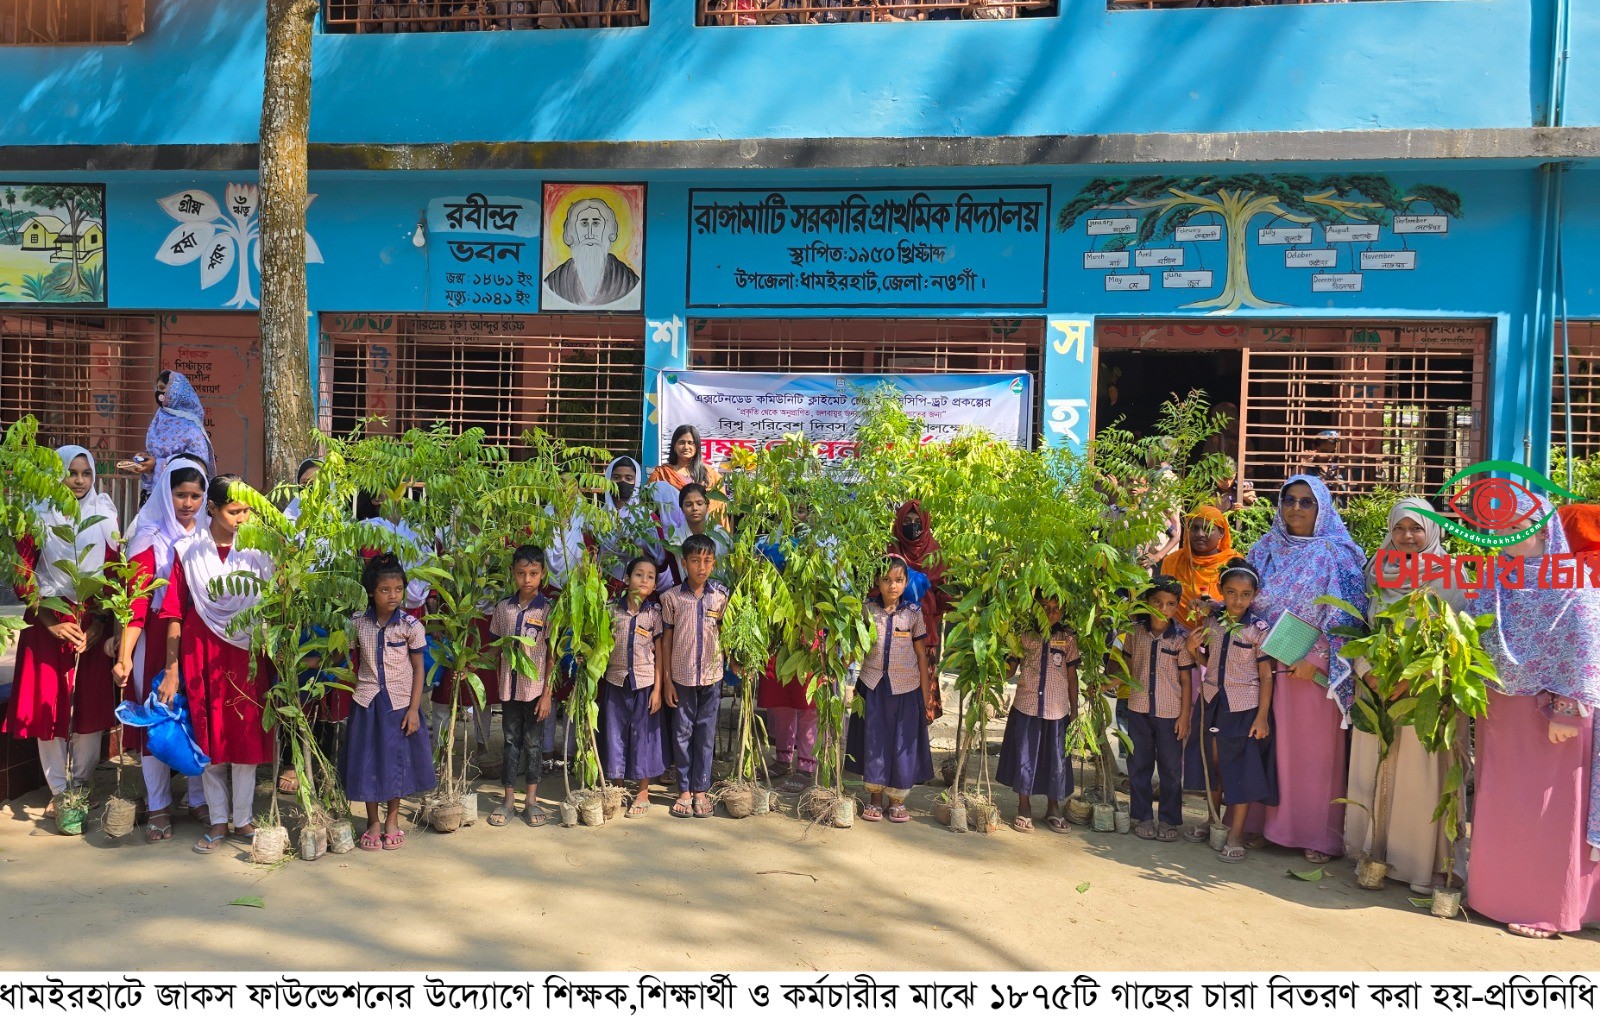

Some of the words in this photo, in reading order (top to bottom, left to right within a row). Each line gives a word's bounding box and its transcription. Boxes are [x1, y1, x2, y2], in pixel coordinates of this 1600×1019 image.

[443, 192, 524, 231] রবীন্দ্র
[694, 193, 788, 234] রাঙ্গামাটি
[790, 194, 870, 234] সরকারি
[868, 192, 953, 234] প্রাথমিক
[955, 192, 1044, 234] বিদ্যালয়
[170, 231, 198, 254] বর্ষা
[446, 240, 526, 264] ভবন
[848, 247, 895, 263] ১৯৫০
[473, 273, 514, 286] ১৮৬১
[517, 270, 533, 287] ইং
[473, 292, 512, 305] ১৯৪১
[515, 289, 530, 306] ইং
[648, 314, 683, 358] শ
[1049, 320, 1091, 364] স
[185, 370, 210, 382] মাশীল
[757, 392, 804, 405] কমিউনিটি
[808, 393, 848, 406] ক্লাইমেট
[952, 396, 991, 408] প্রকল্পের
[718, 417, 745, 431] বিশ্ব
[750, 418, 804, 431] পরিবেশ
[810, 418, 846, 431] দিবস
[1046, 399, 1088, 446] হ
